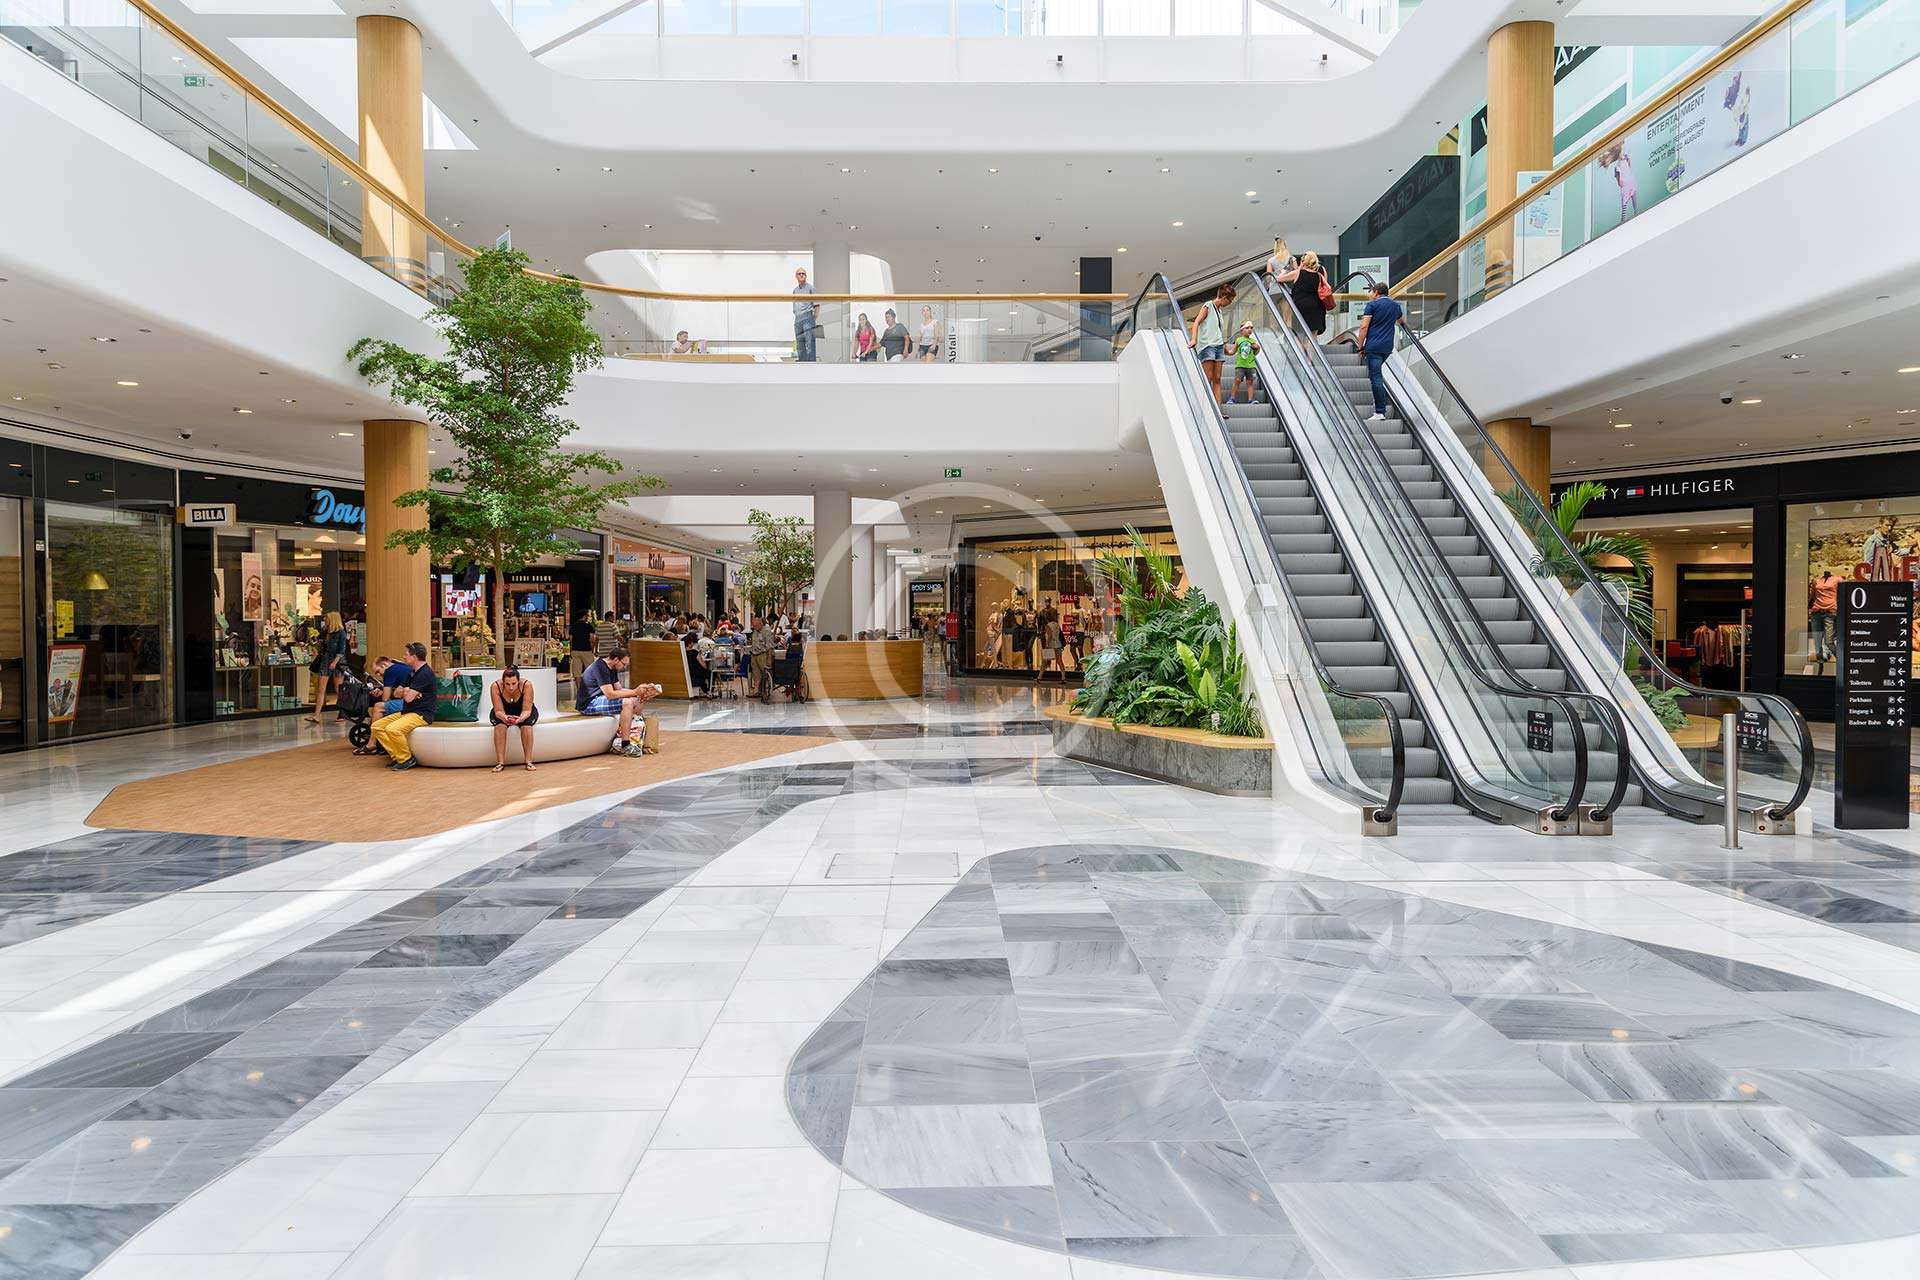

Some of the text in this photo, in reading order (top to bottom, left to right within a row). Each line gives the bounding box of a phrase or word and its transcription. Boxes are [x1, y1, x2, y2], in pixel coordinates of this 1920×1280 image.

[1647, 93, 1704, 140] ENTERTANMENT
[949, 334, 957, 363] Abfall
[1651, 478, 1735, 497] HILFIGER
[193, 510, 225, 521] BILLA
[911, 584, 926, 592] BODY
[1851, 587, 1867, 609] 0
